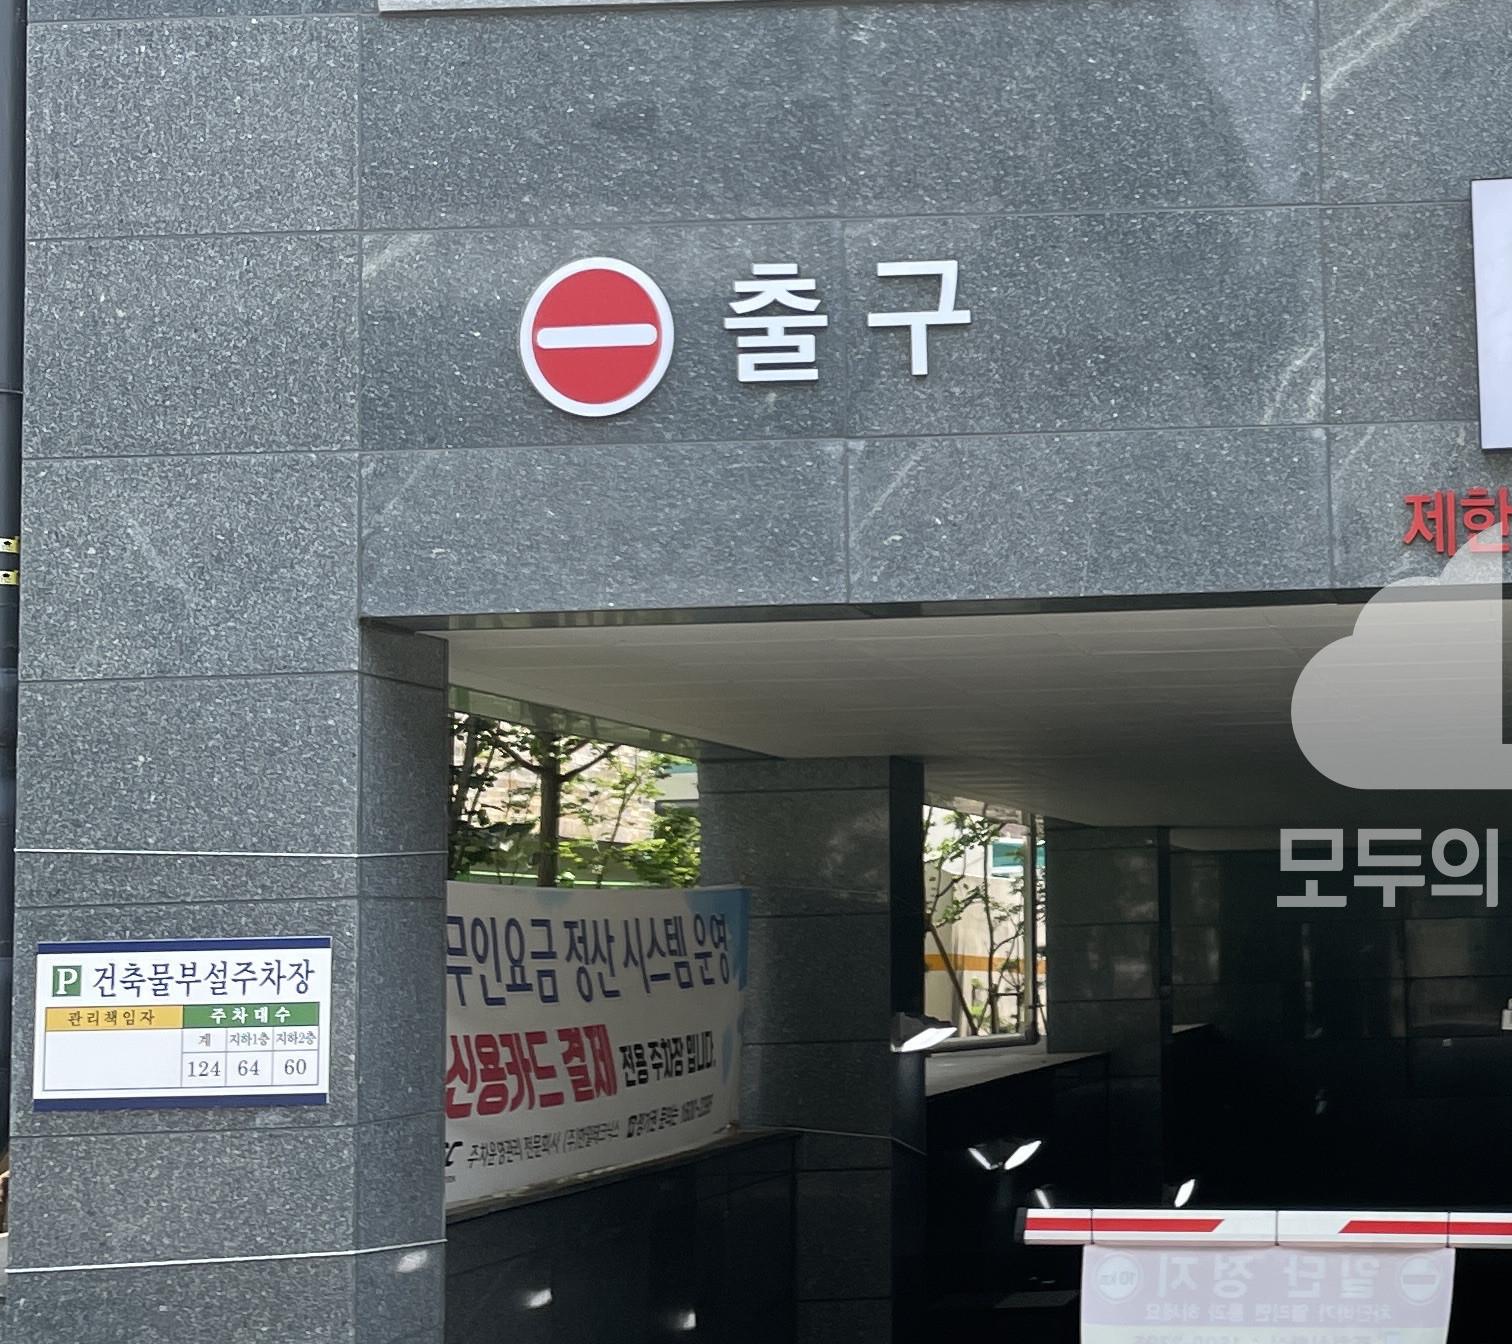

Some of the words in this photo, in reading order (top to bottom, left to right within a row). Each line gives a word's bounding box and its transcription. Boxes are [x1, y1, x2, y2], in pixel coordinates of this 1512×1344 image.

[724, 260, 971, 382] 출구
[563, 918, 621, 1003] 정산
[693, 913, 730, 986] 운영
[56, 967, 78, 995] P
[92, 958, 316, 998] 건축물부설주차장
[67, 1009, 156, 1027] 관리책임자
[209, 1006, 292, 1025] 주차대수
[228, 1031, 271, 1047] 지하1층
[275, 1030, 317, 1046] 지하2층
[187, 1060, 222, 1078] 124
[237, 1059, 260, 1077] 64
[284, 1058, 307, 1076] 60
[619, 1043, 648, 1087] 전용
[648, 1037, 683, 1081] 주차장
[445, 1030, 565, 1120] 신용카드
[556, 1024, 617, 1102] 결제
